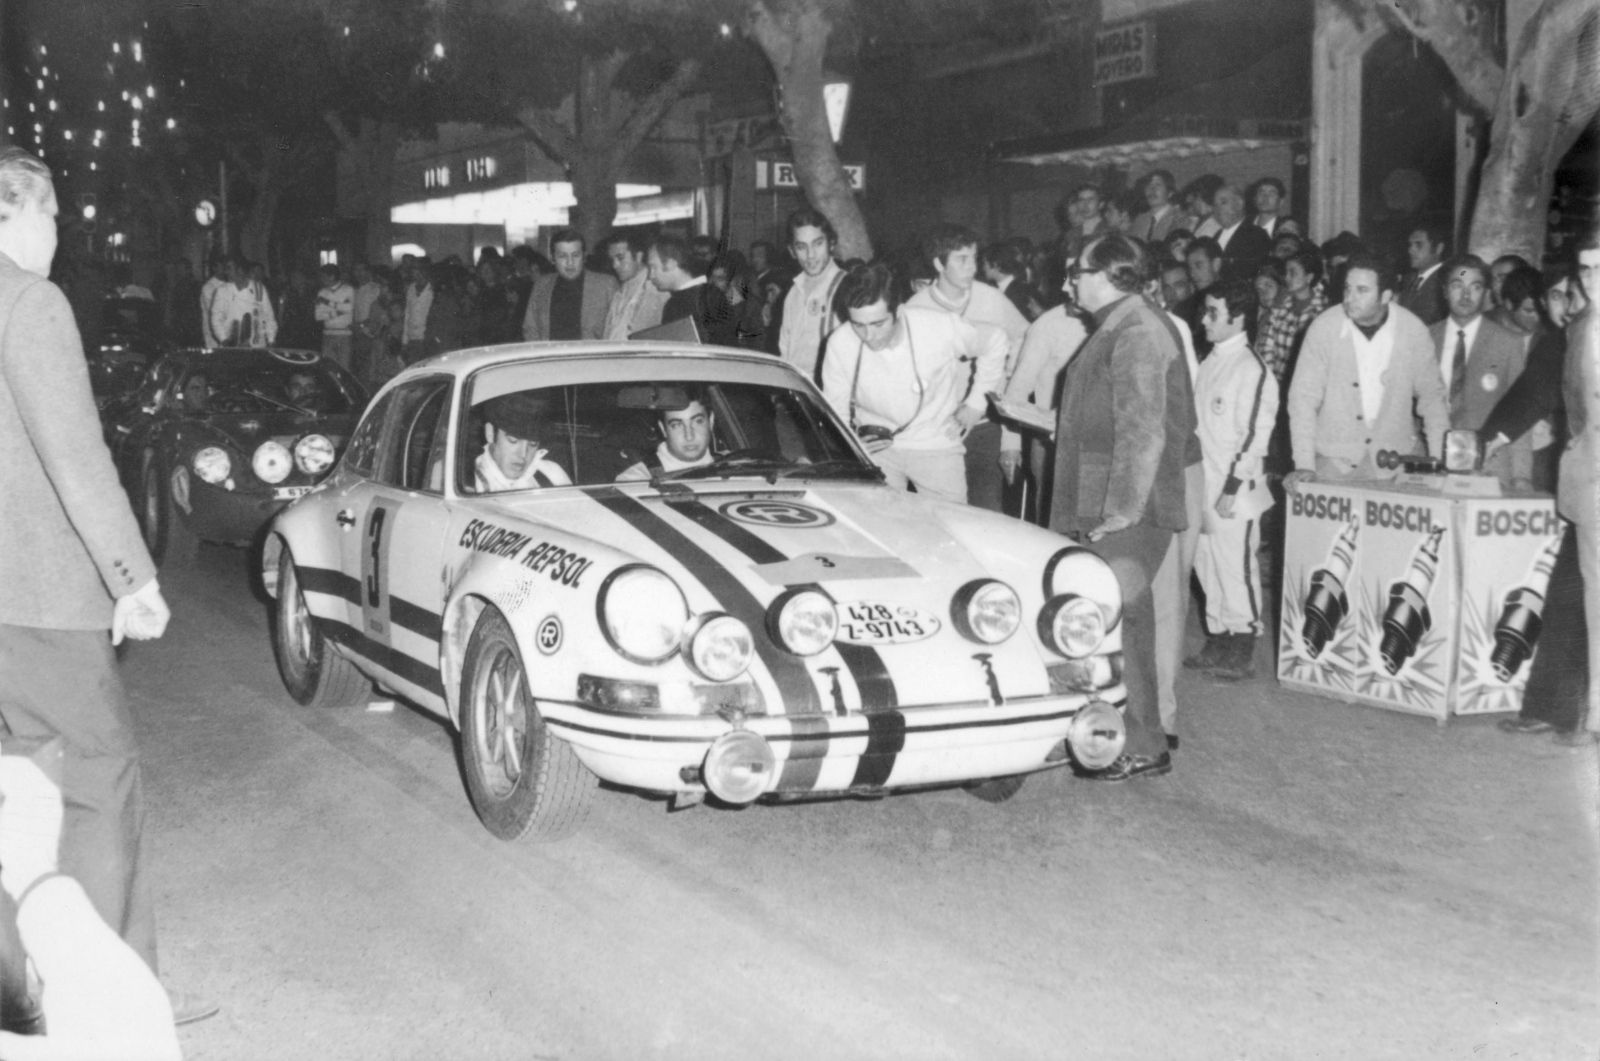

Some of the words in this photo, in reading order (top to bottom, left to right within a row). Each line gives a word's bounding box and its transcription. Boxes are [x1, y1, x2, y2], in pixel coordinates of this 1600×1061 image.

[1292, 492, 1351, 523] BOSCH
[1365, 499, 1432, 534] BOSCH
[1476, 509, 1560, 536] BOSCH
[366, 506, 386, 609] 3
[458, 518, 533, 560] ESCUDERIA
[520, 542, 594, 589] REPSOL
[814, 555, 836, 568] 3
[848, 604, 893, 621] 428
